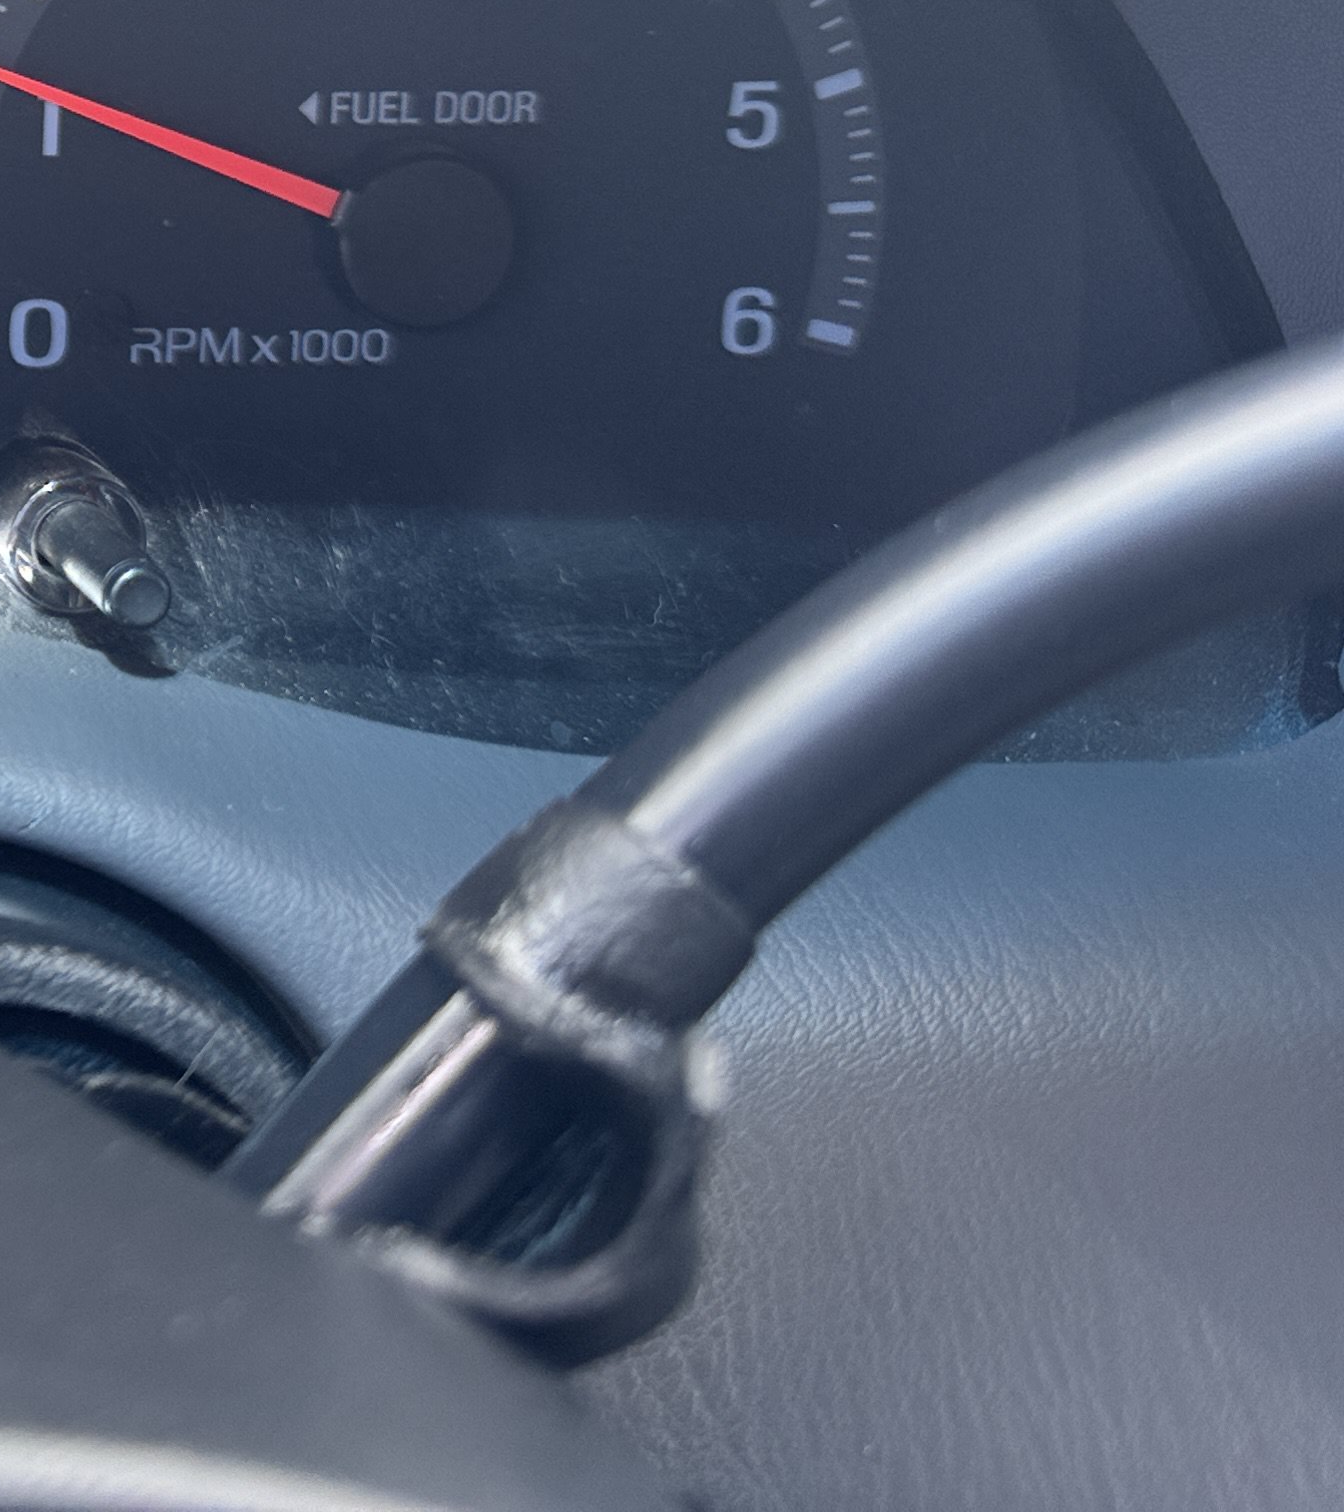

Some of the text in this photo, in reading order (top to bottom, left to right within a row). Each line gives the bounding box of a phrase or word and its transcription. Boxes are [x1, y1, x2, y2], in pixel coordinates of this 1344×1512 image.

[330, 90, 538, 125] FUEL DOOR
[727, 80, 779, 149] 5
[9, 298, 68, 368] 0
[723, 287, 775, 355] 6
